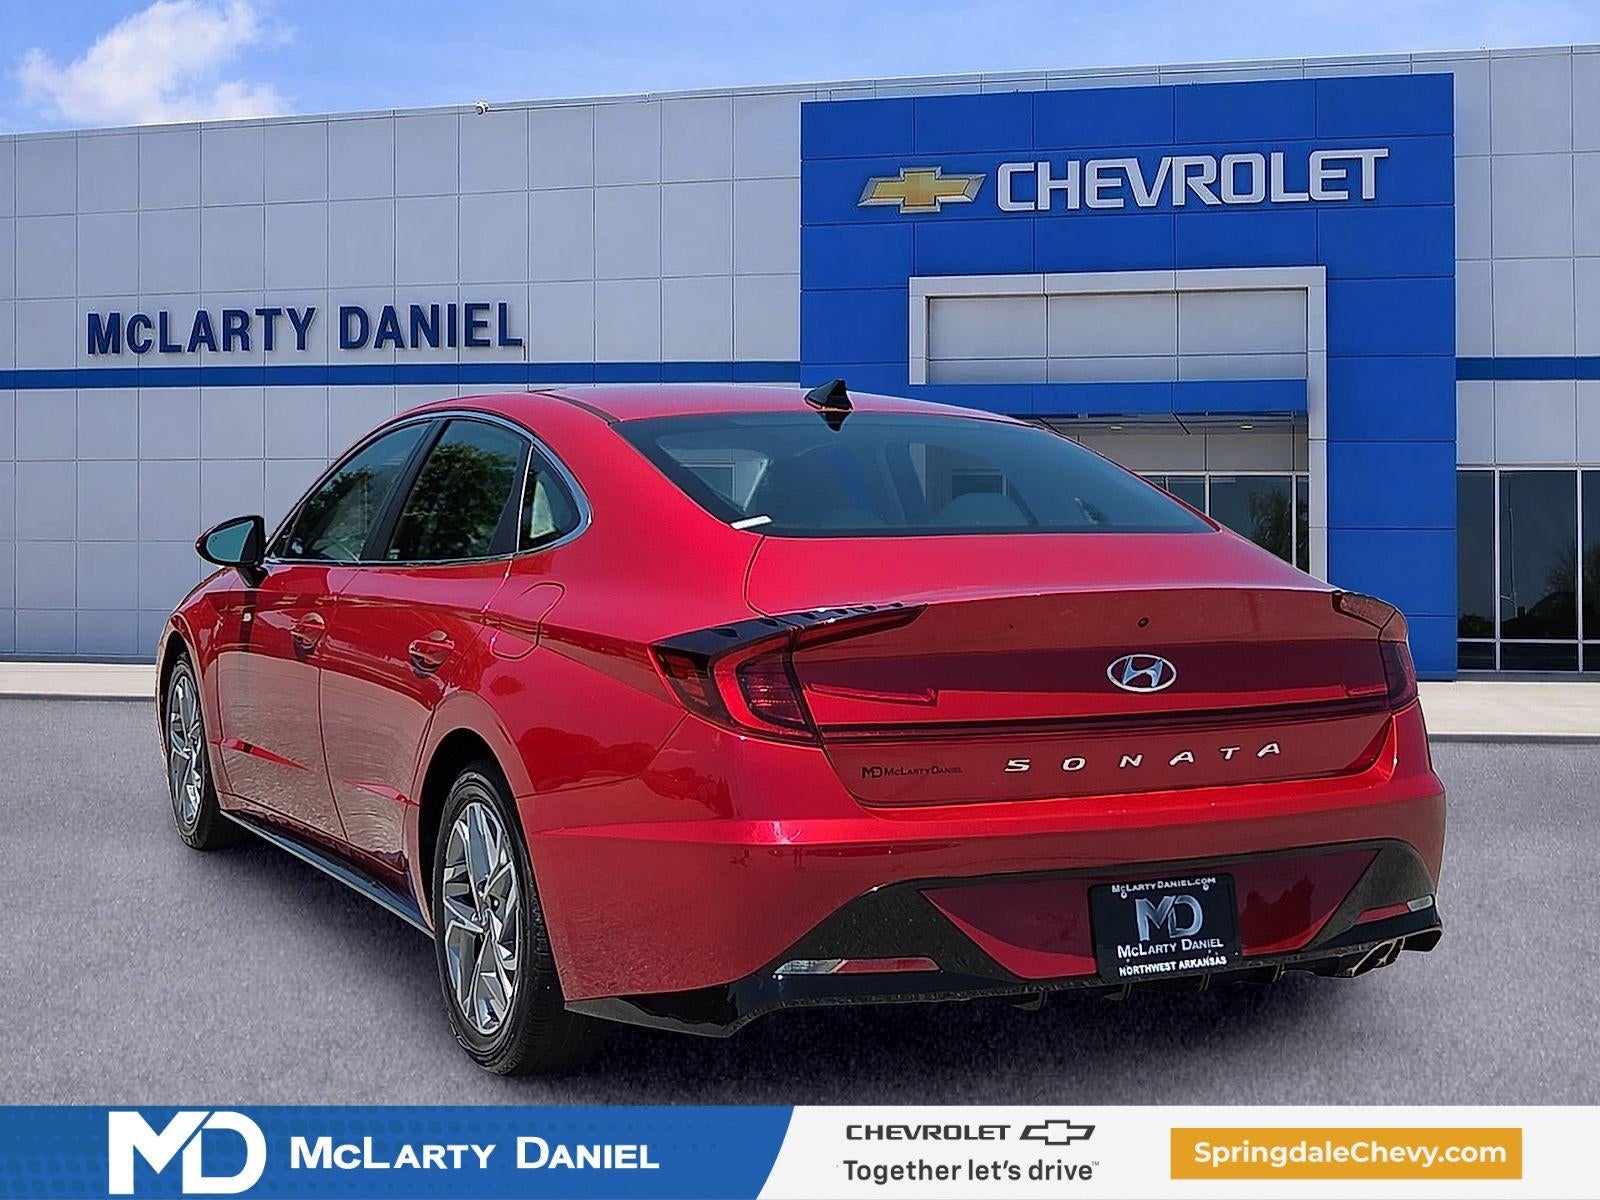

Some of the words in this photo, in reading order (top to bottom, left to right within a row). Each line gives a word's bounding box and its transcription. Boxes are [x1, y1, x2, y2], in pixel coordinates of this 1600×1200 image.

[996, 148, 1389, 213] CHEVROLET
[339, 301, 524, 350] DANIEL
[1004, 741, 1282, 773] SONATA
[1135, 894, 1204, 942] MD
[1119, 963, 1177, 977] NORTHWEST
[1178, 956, 1228, 969] ARKANSAS
